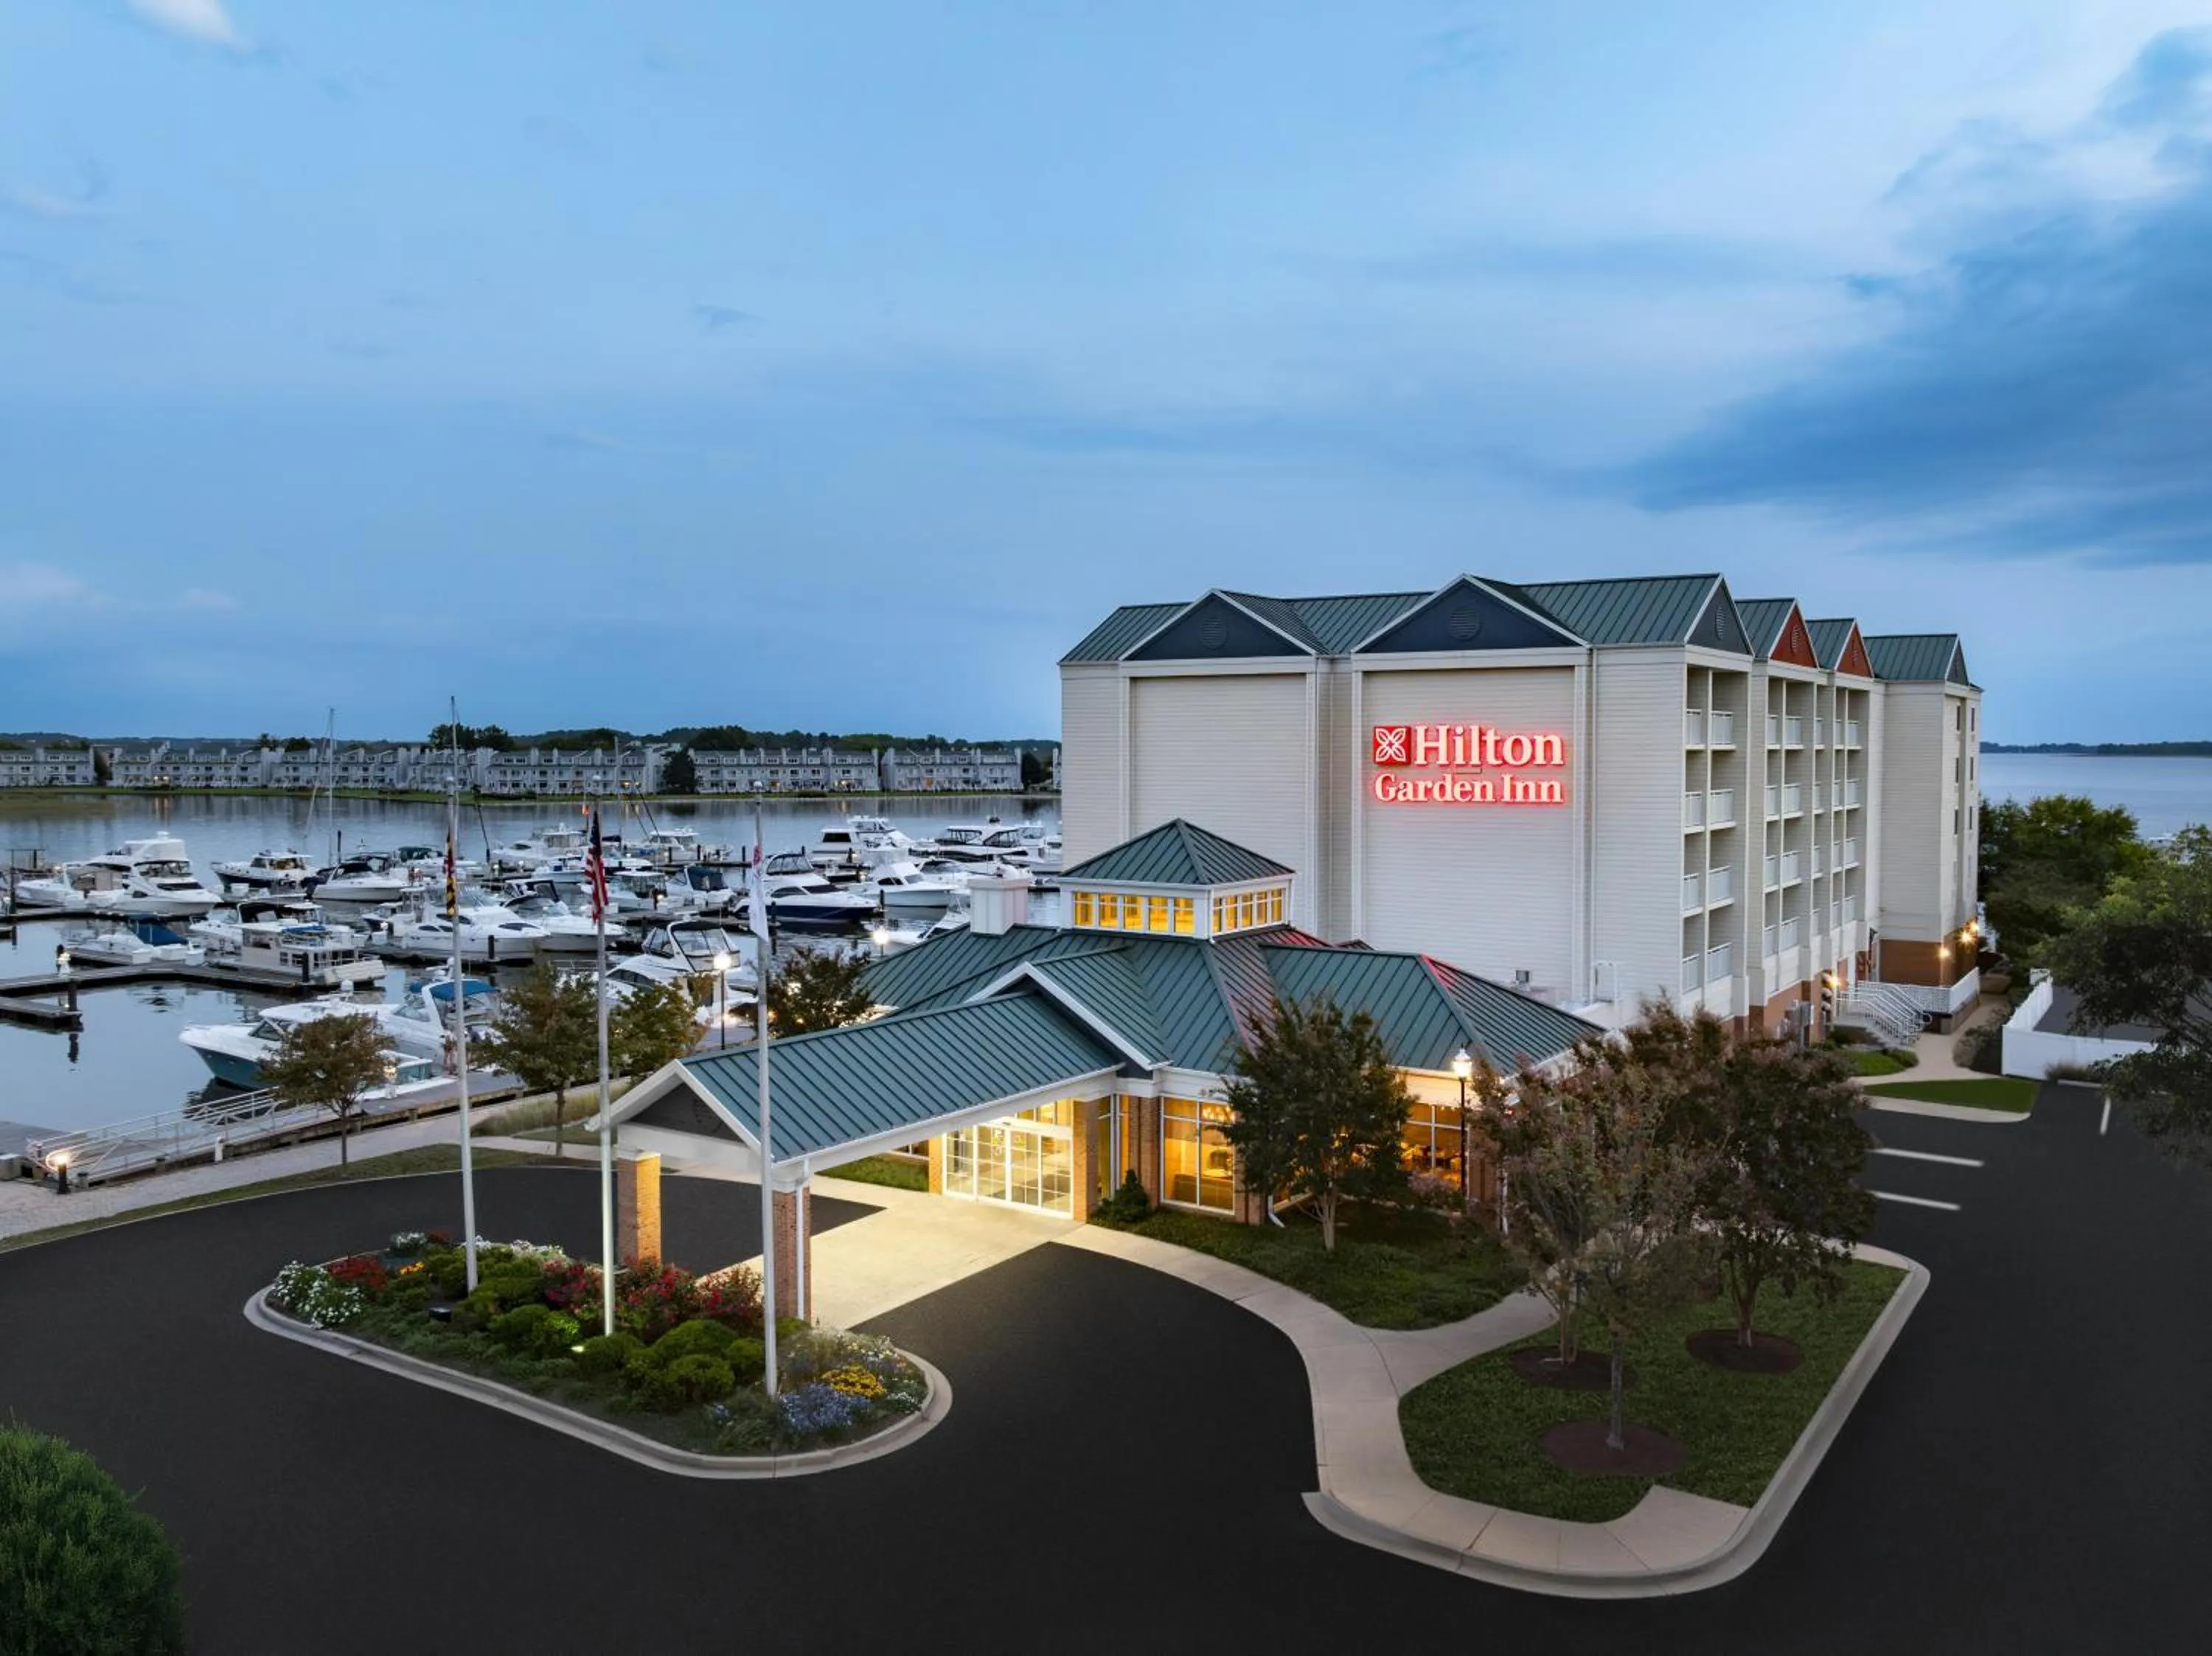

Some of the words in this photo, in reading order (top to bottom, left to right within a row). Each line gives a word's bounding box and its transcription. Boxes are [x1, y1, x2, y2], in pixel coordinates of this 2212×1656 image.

[1415, 725, 1564, 765] Hilton
[1374, 773, 1496, 803] Garden
[1501, 774, 1563, 803] Inn
